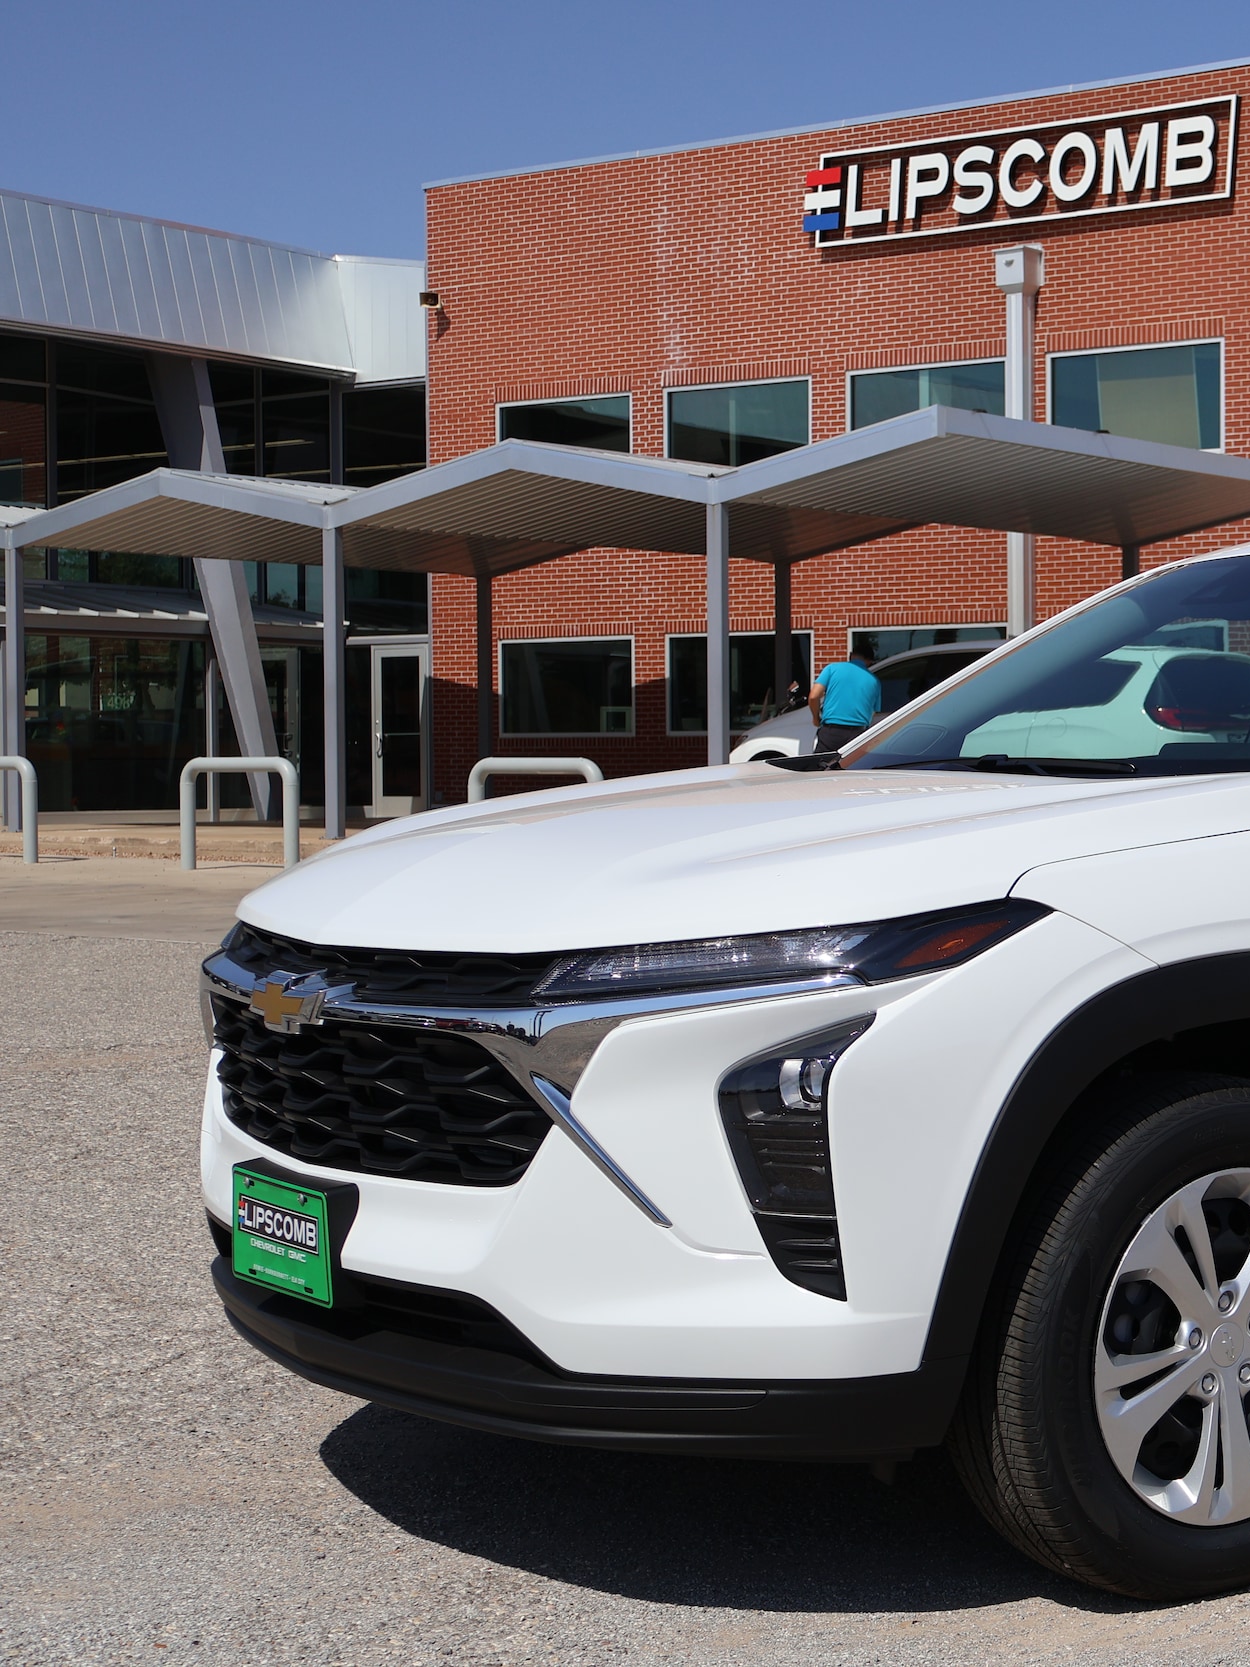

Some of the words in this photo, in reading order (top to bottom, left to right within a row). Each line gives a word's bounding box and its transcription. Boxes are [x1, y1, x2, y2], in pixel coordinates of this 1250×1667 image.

[845, 115, 1216, 227] LIPSCOMB
[244, 1202, 316, 1247] LIPSCOMB
[250, 1238, 285, 1256] CHEVROLET
[288, 1250, 306, 1263] GMC
